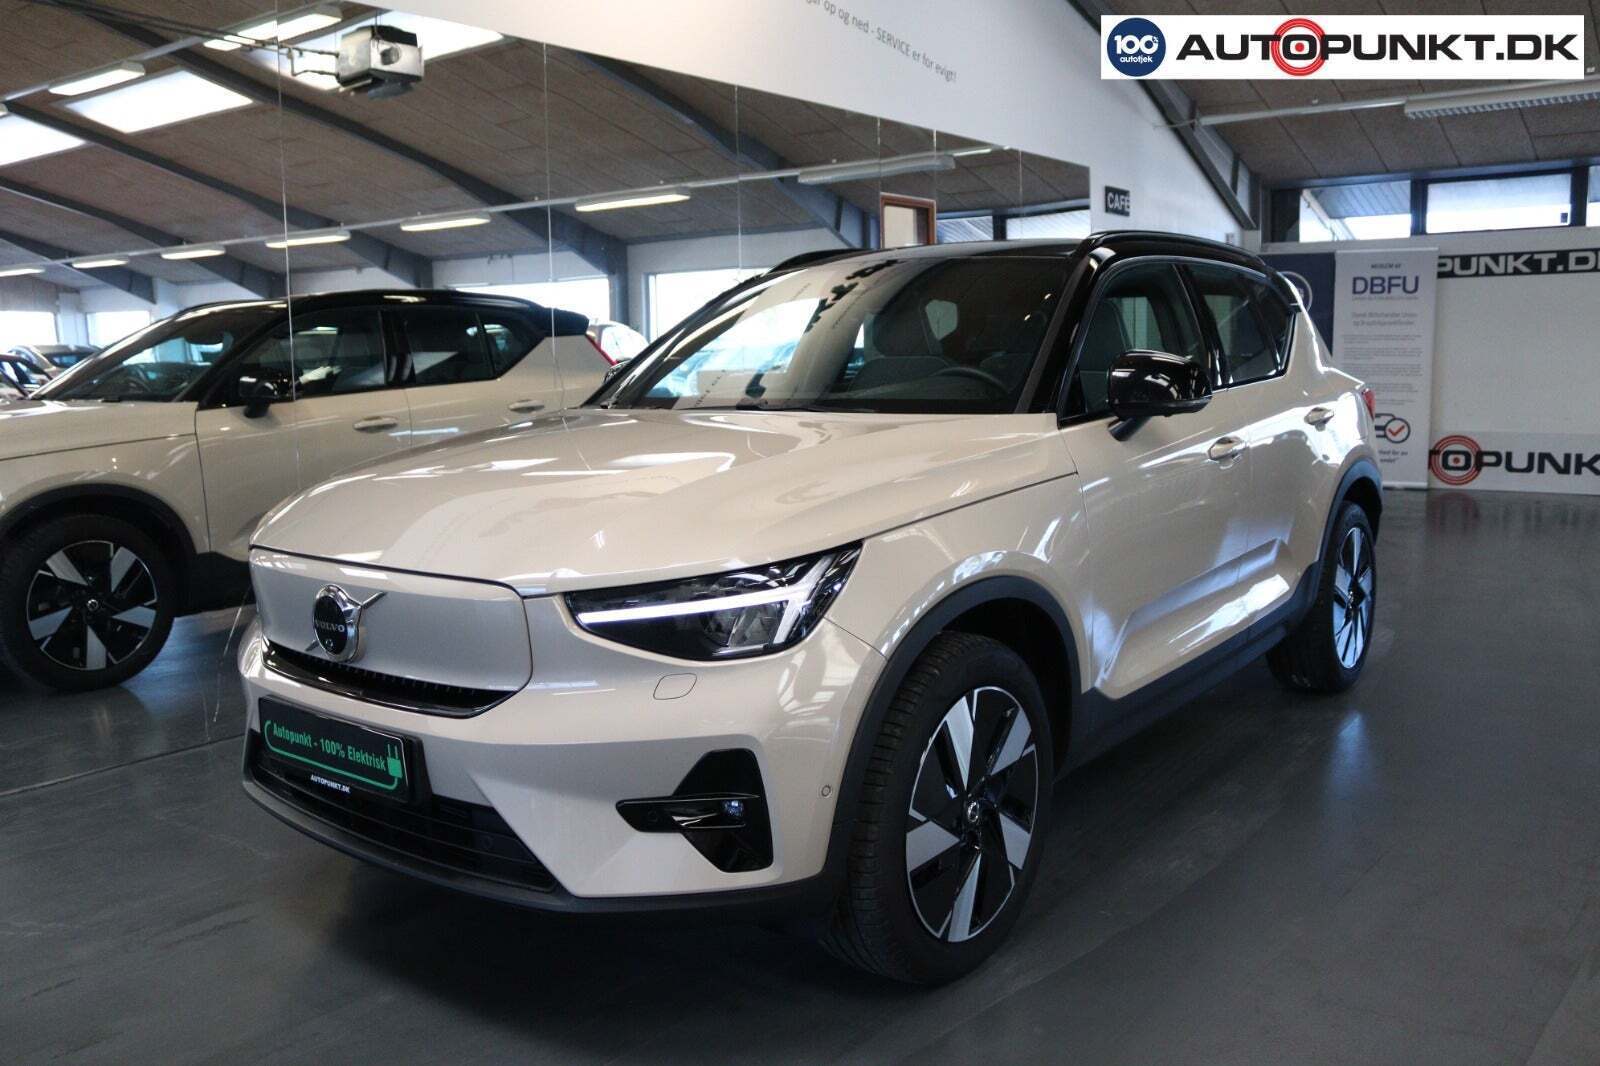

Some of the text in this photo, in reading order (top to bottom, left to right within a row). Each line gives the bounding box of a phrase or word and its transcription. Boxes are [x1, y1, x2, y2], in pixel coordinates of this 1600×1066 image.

[838, 8, 850, 26] og
[852, 16, 869, 33] ned
[876, 27, 911, 57] SERVICE
[912, 50, 921, 62] er
[922, 52, 934, 69] for
[1437, 250, 1600, 276] PUNKT.D
[1352, 275, 1419, 295] DBFU
[315, 620, 345, 632] VOLVO
[273, 723, 312, 748] Autopunkt
[320, 738, 345, 758] 100%
[347, 745, 386, 771] Elektrisk
[310, 774, 350, 793] AUTOPUNKT.DK
